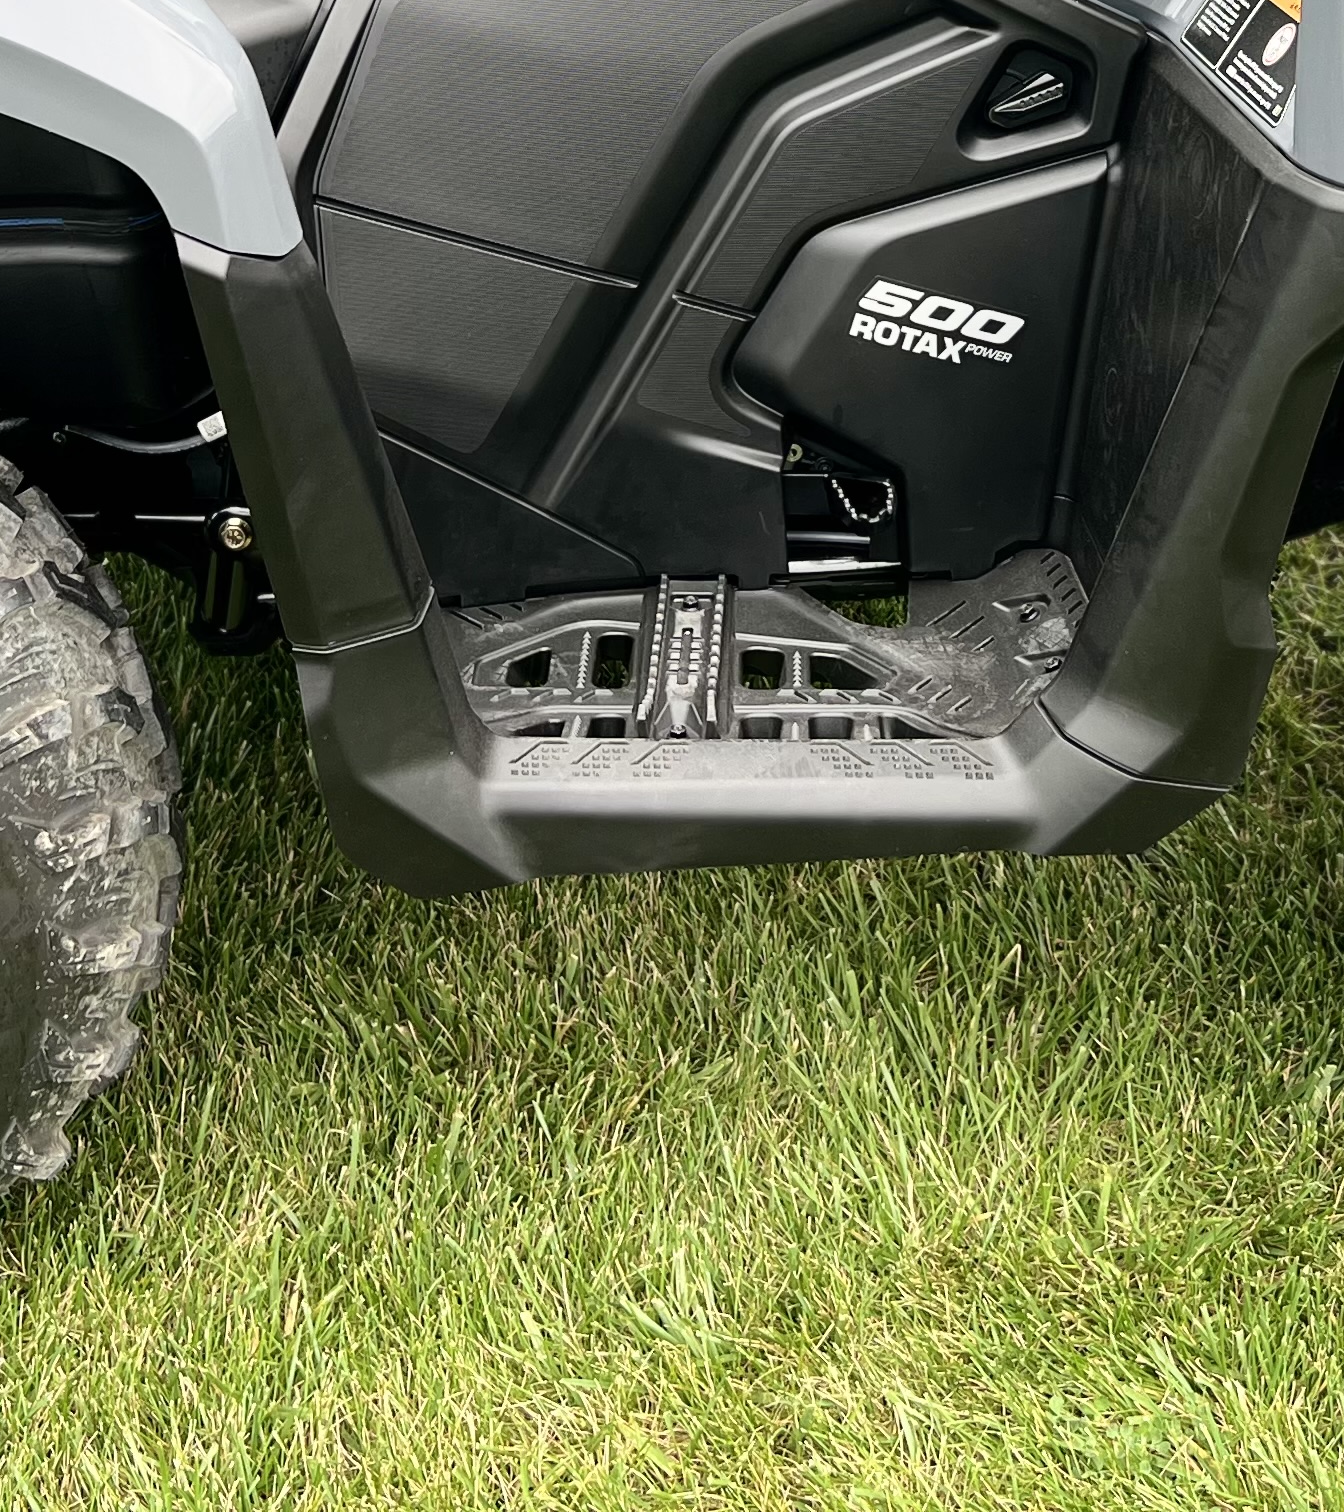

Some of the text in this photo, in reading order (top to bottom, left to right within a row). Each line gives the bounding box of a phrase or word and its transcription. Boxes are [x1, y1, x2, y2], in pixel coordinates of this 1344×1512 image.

[858, 279, 1025, 344] 500
[848, 317, 1013, 364] ROTAX POWER
